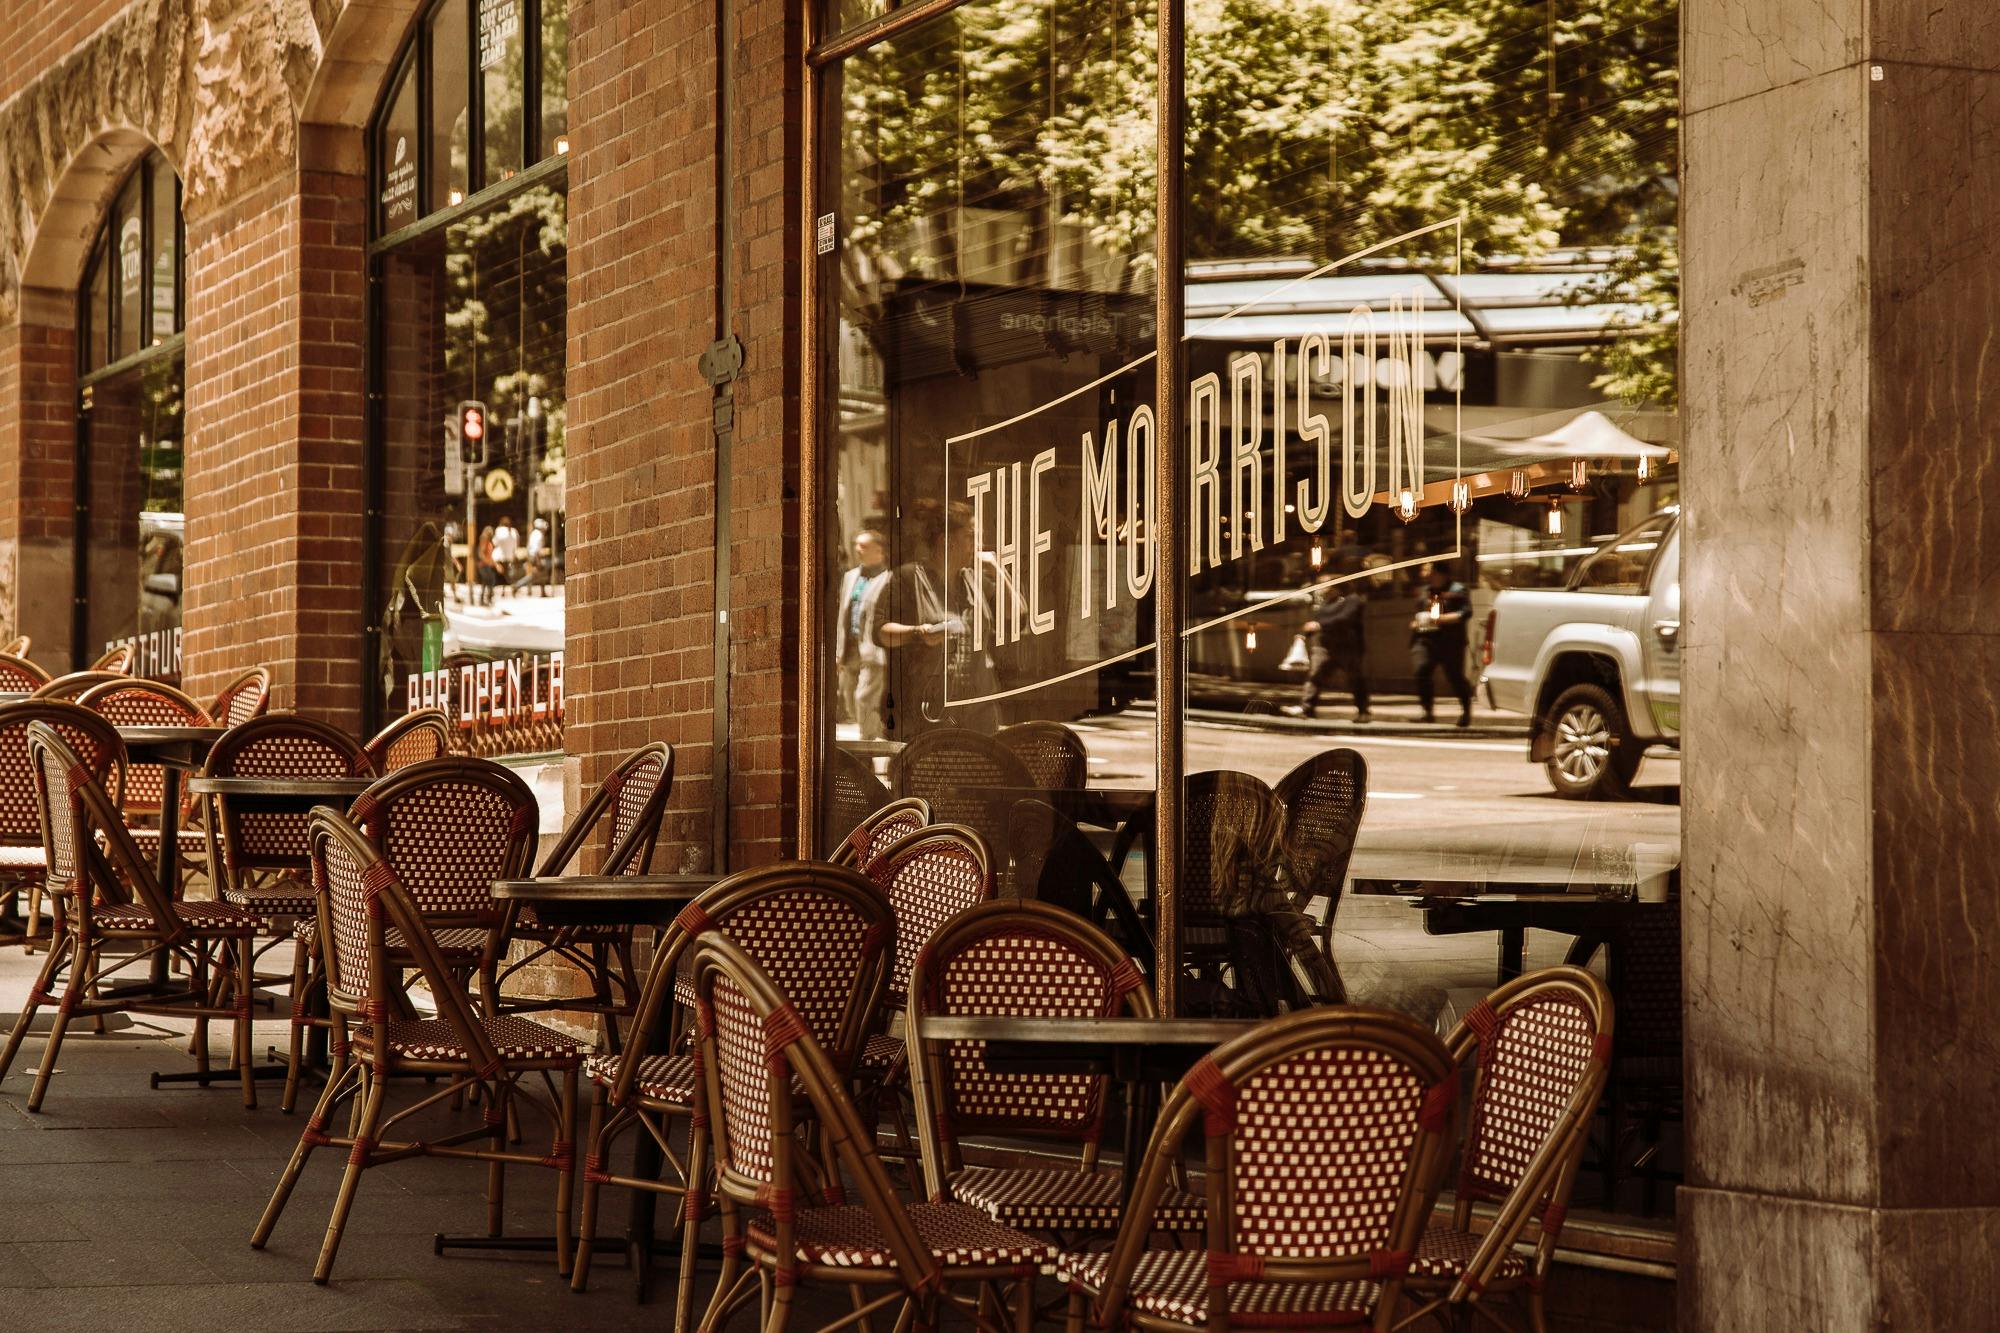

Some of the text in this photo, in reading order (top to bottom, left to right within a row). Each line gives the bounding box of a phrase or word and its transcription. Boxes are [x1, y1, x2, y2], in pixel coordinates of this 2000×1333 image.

[966, 285, 1425, 653] THE MORRISON
[408, 669, 449, 720] BAR
[460, 657, 521, 725] OPEN
